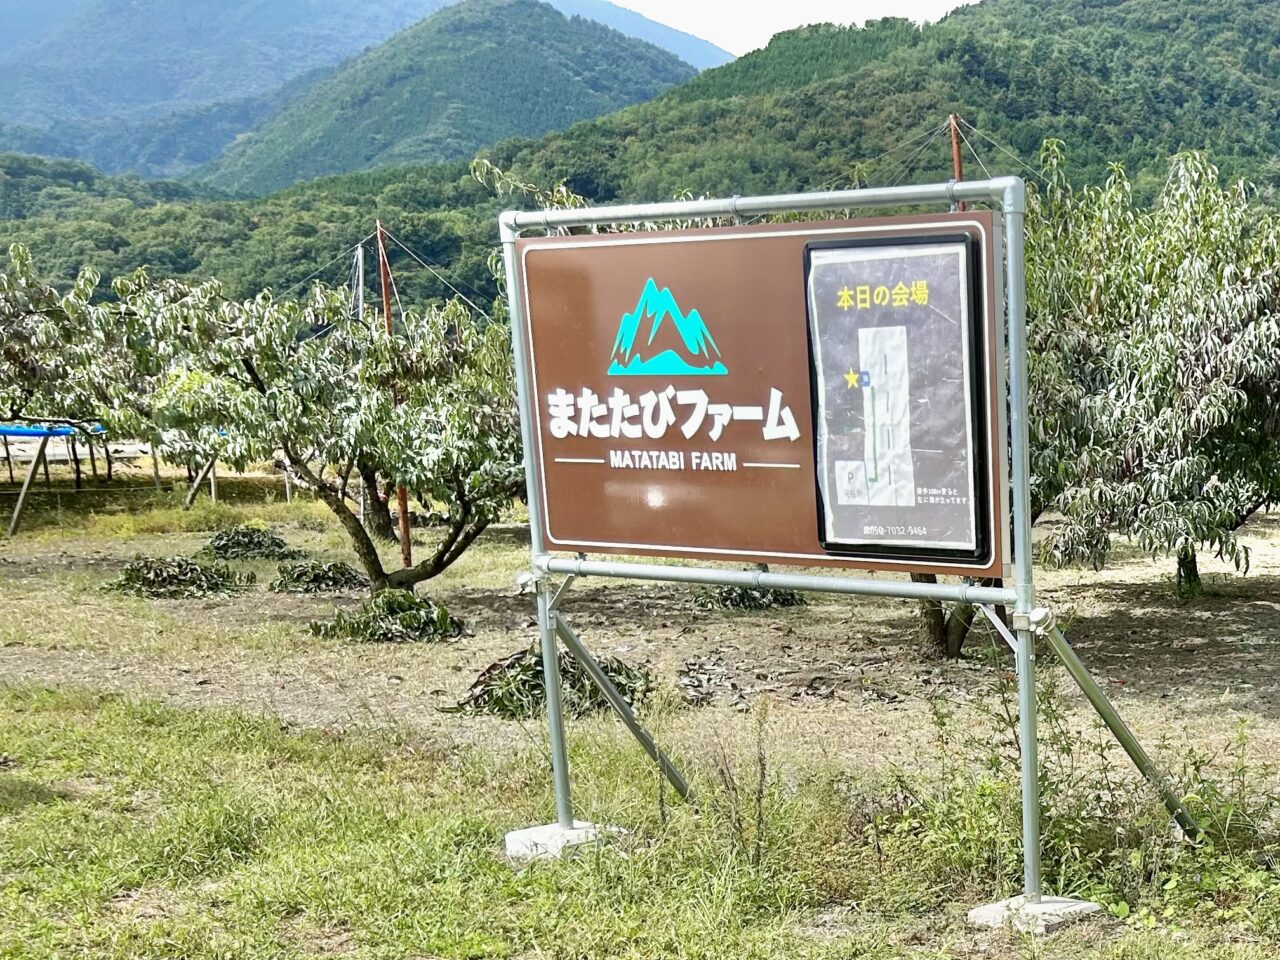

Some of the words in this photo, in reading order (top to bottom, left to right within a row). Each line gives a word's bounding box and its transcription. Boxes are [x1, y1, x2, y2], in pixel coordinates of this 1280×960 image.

[837, 280, 929, 311] 本日の会場
[547, 384, 801, 442] またたびファーム
[609, 450, 684, 470] MATATABI
[691, 452, 737, 471] FARM
